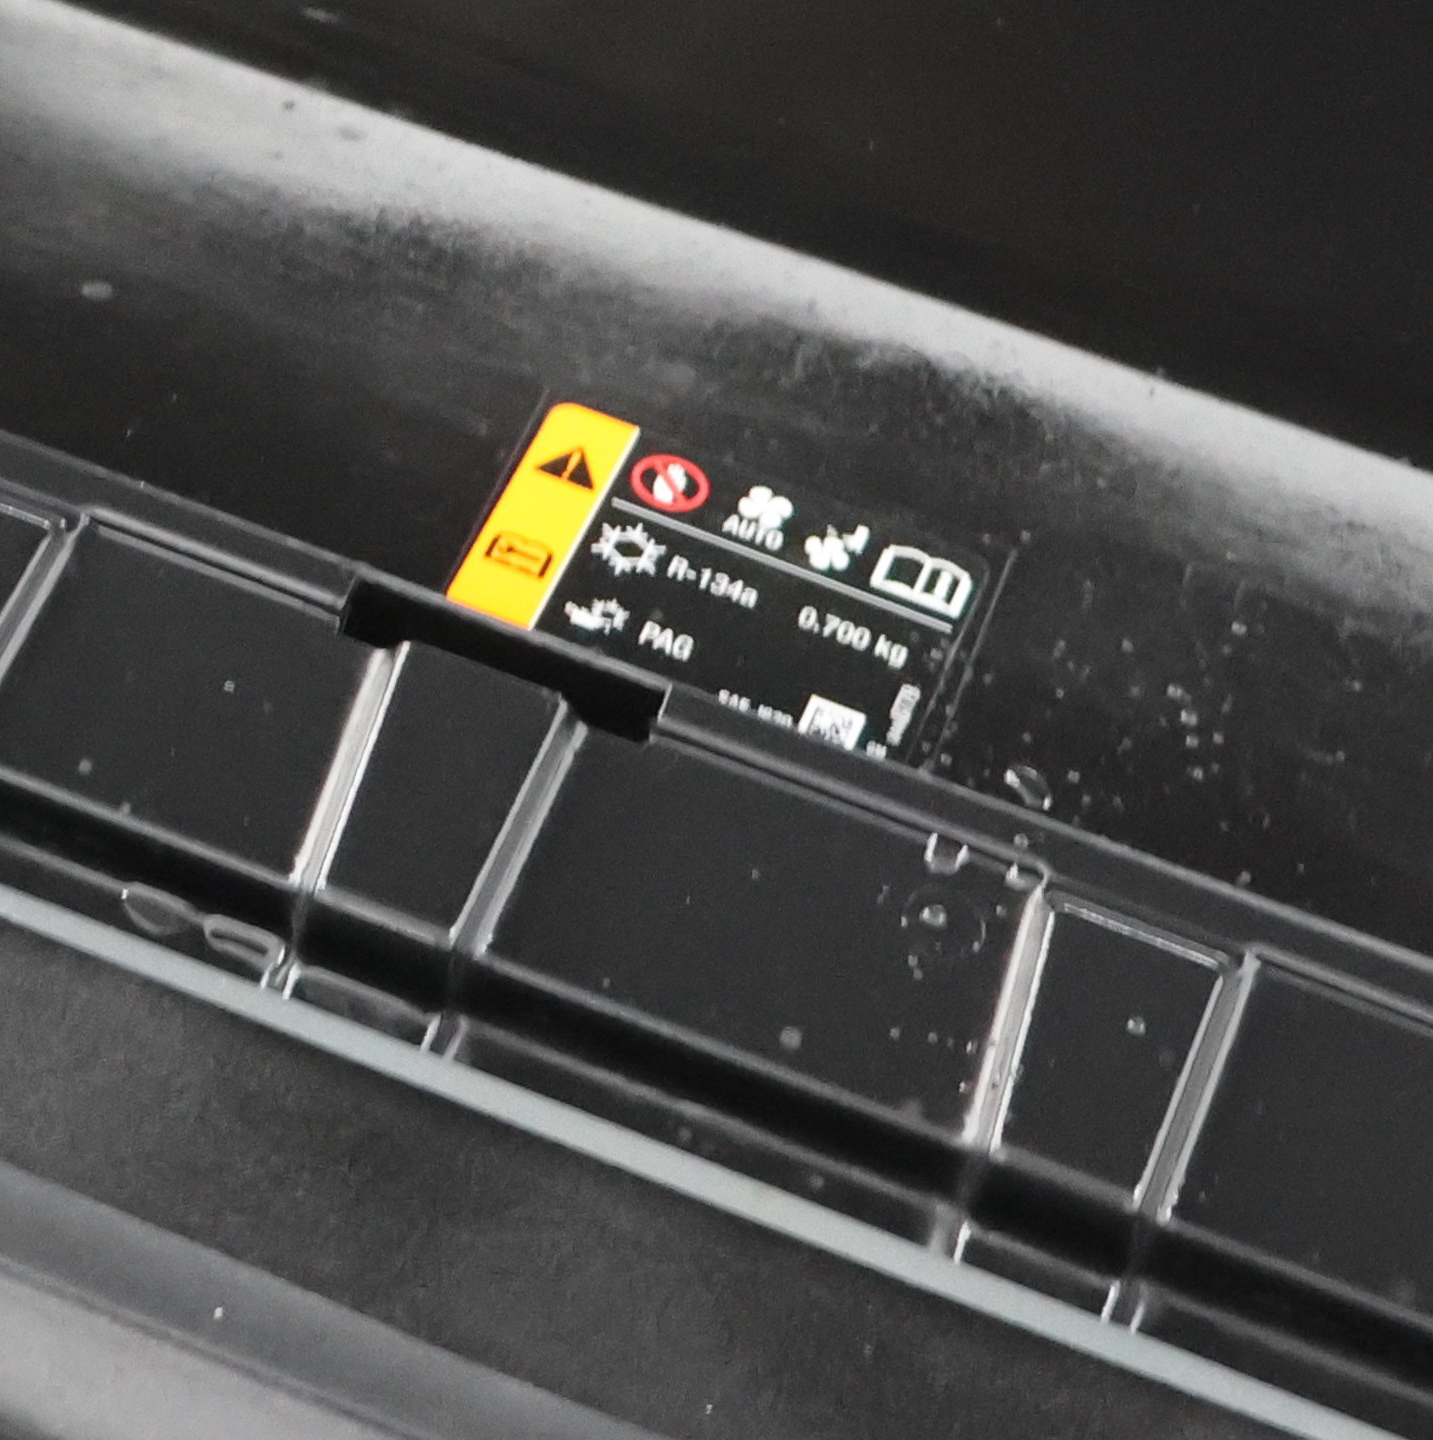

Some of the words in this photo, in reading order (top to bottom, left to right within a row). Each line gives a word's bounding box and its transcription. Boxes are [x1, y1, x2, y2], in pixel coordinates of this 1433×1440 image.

[721, 513, 785, 552] AUTO
[666, 554, 759, 610] R-134a
[797, 605, 872, 652] 0.700
[874, 633, 909, 670] kg
[638, 620, 695, 662] PAG
